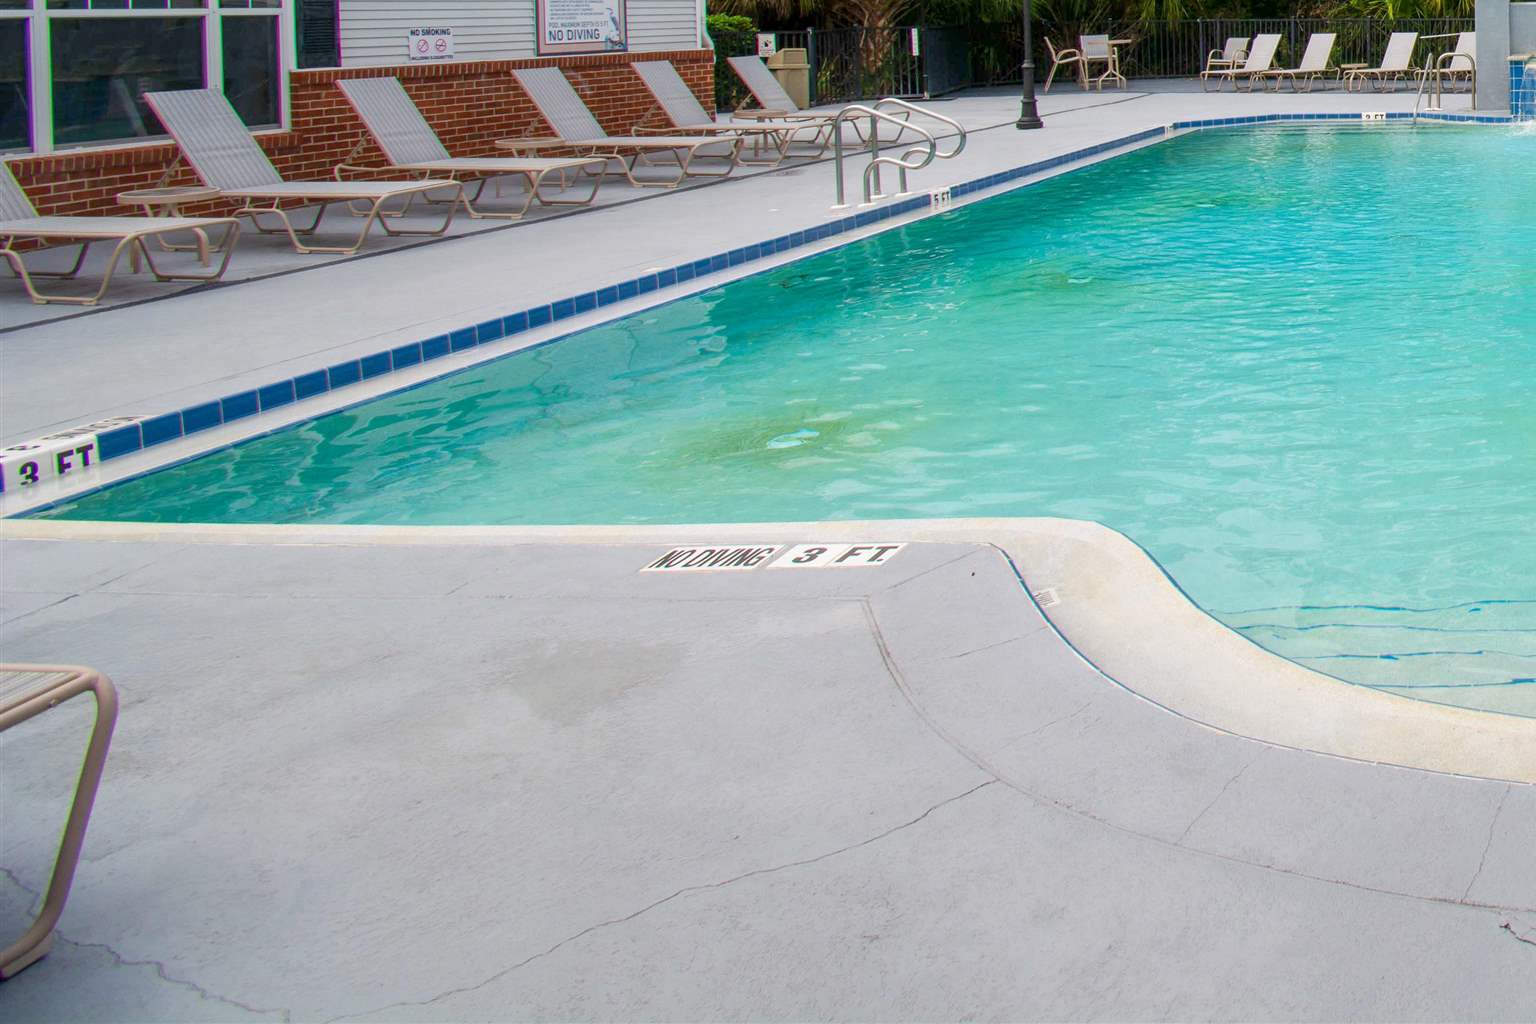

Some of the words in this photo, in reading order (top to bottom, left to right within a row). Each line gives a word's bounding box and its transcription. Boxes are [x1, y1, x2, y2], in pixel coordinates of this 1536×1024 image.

[410, 28, 420, 36] NO
[421, 28, 451, 36] SMOKING
[549, 29, 564, 41] NO
[567, 28, 600, 40] DIVING
[941, 190, 950, 202] FT
[19, 461, 40, 485] 3
[57, 443, 95, 474] FT
[648, 549, 698, 568] NO
[681, 547, 775, 567] DIVING
[791, 547, 828, 564] 3
